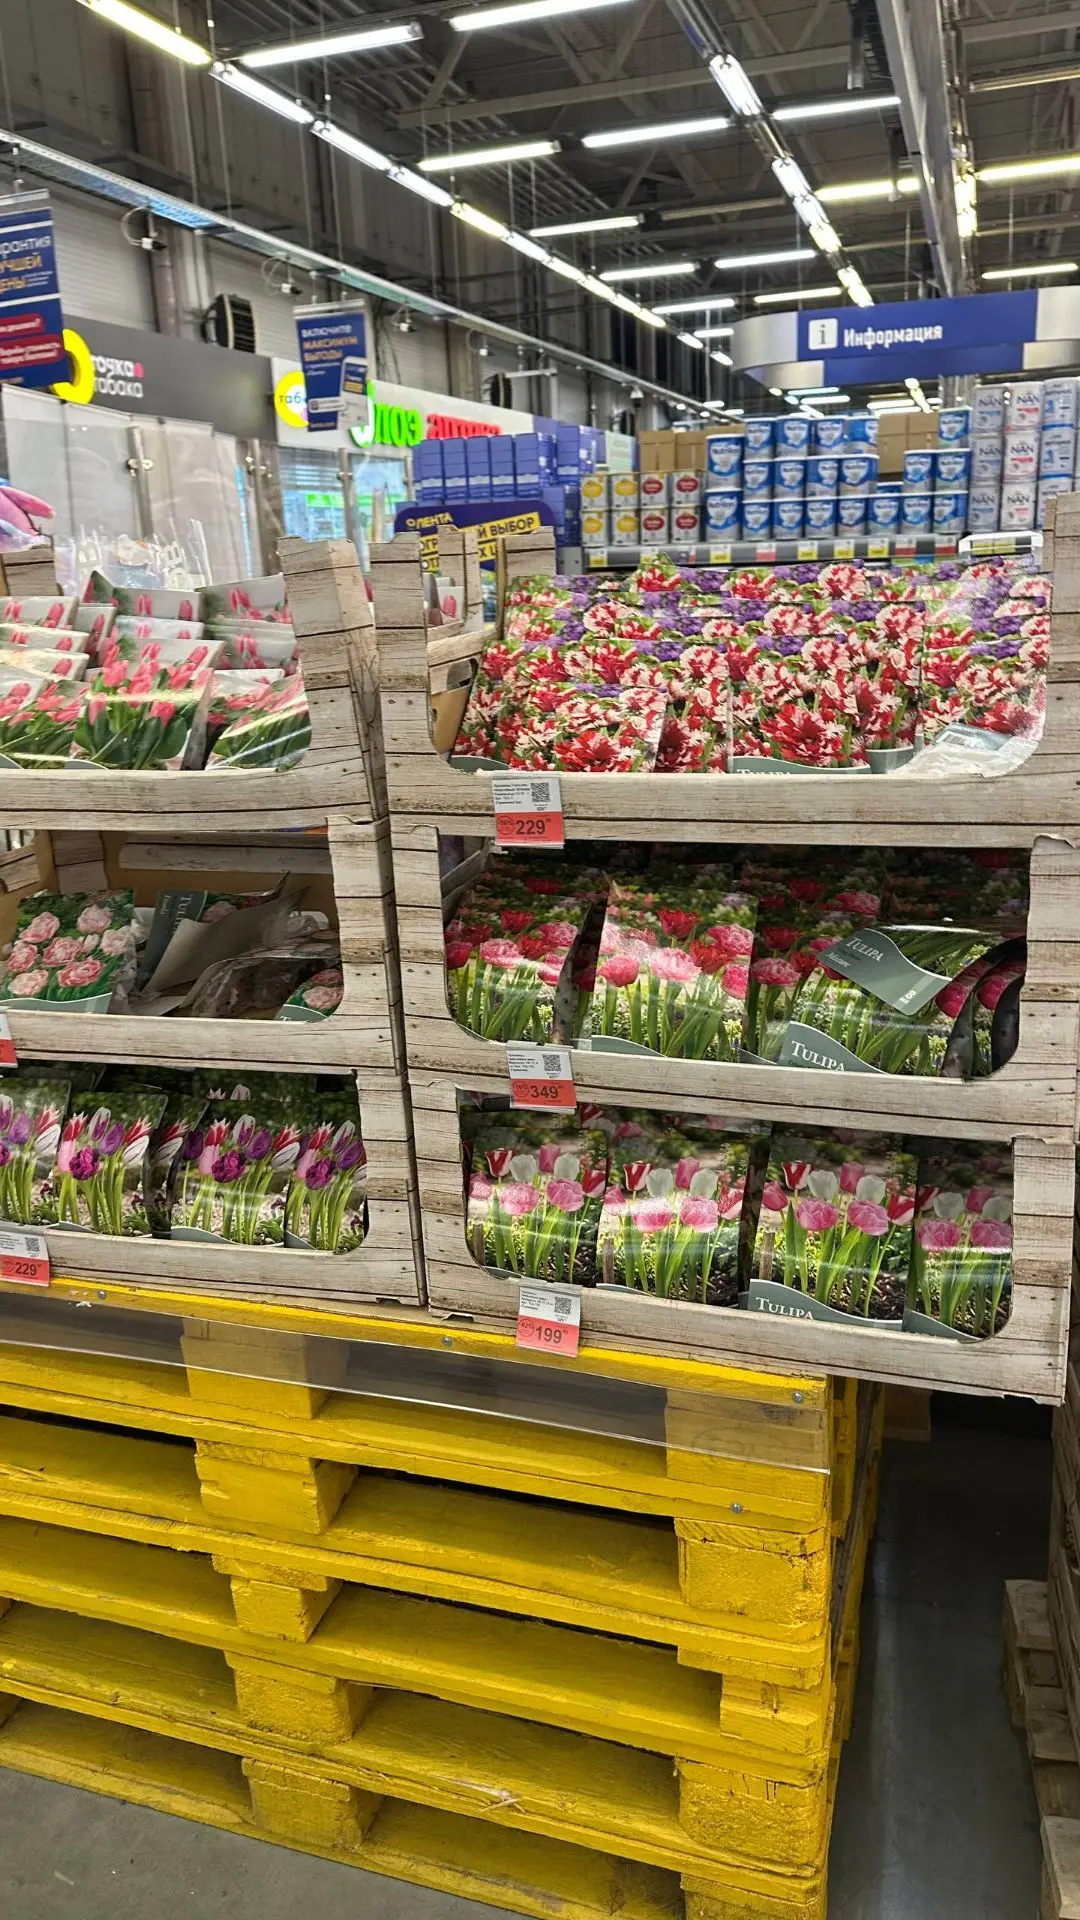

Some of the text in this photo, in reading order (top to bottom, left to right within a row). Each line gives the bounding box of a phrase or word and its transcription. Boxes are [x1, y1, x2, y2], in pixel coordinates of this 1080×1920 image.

[844, 325, 943, 350] Информация
[416, 512, 453, 528] ЛЕНТА
[491, 516, 535, 537] ВЫБОР
[516, 820, 545, 835] 229
[846, 936, 884, 962] TULIPA
[791, 1040, 845, 1071] TULIPA
[530, 1085, 558, 1099] 349
[15, 1262, 37, 1276] 229
[755, 1296, 814, 1320] TULIPA
[535, 1326, 562, 1344] 199
